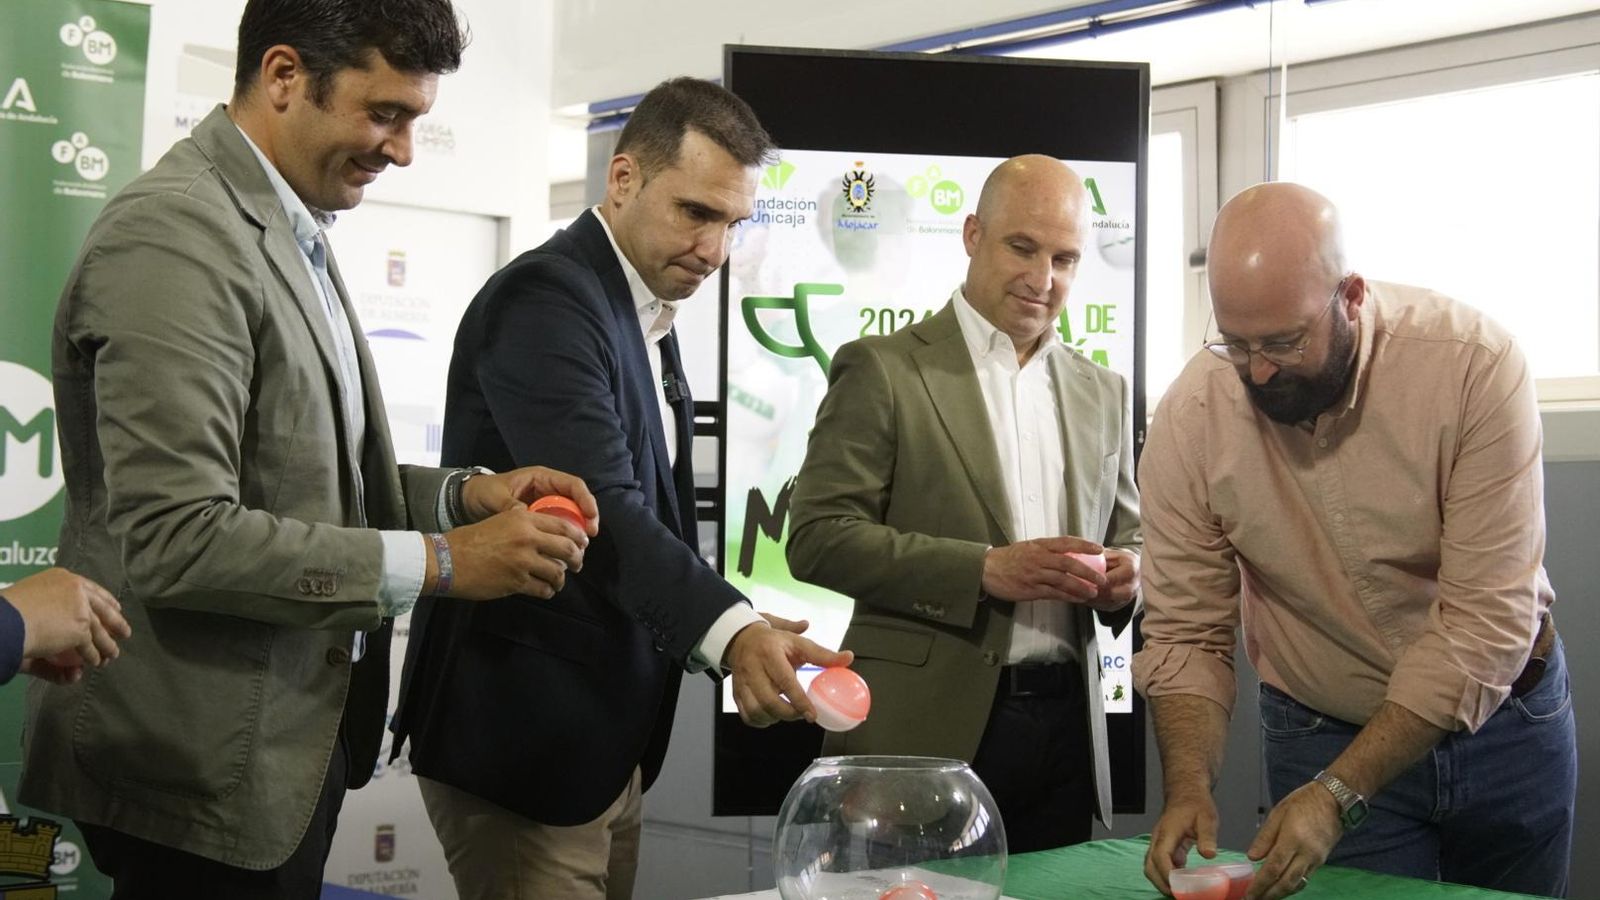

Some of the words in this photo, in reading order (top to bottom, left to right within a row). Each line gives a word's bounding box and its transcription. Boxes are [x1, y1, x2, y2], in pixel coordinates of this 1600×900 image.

[88, 40, 112, 55] BM
[80, 156, 104, 172] BM
[934, 188, 961, 207] BM
[751, 211, 805, 228] Unicaja
[1086, 304, 1117, 334] DE
[1103, 656, 1125, 669] RC
